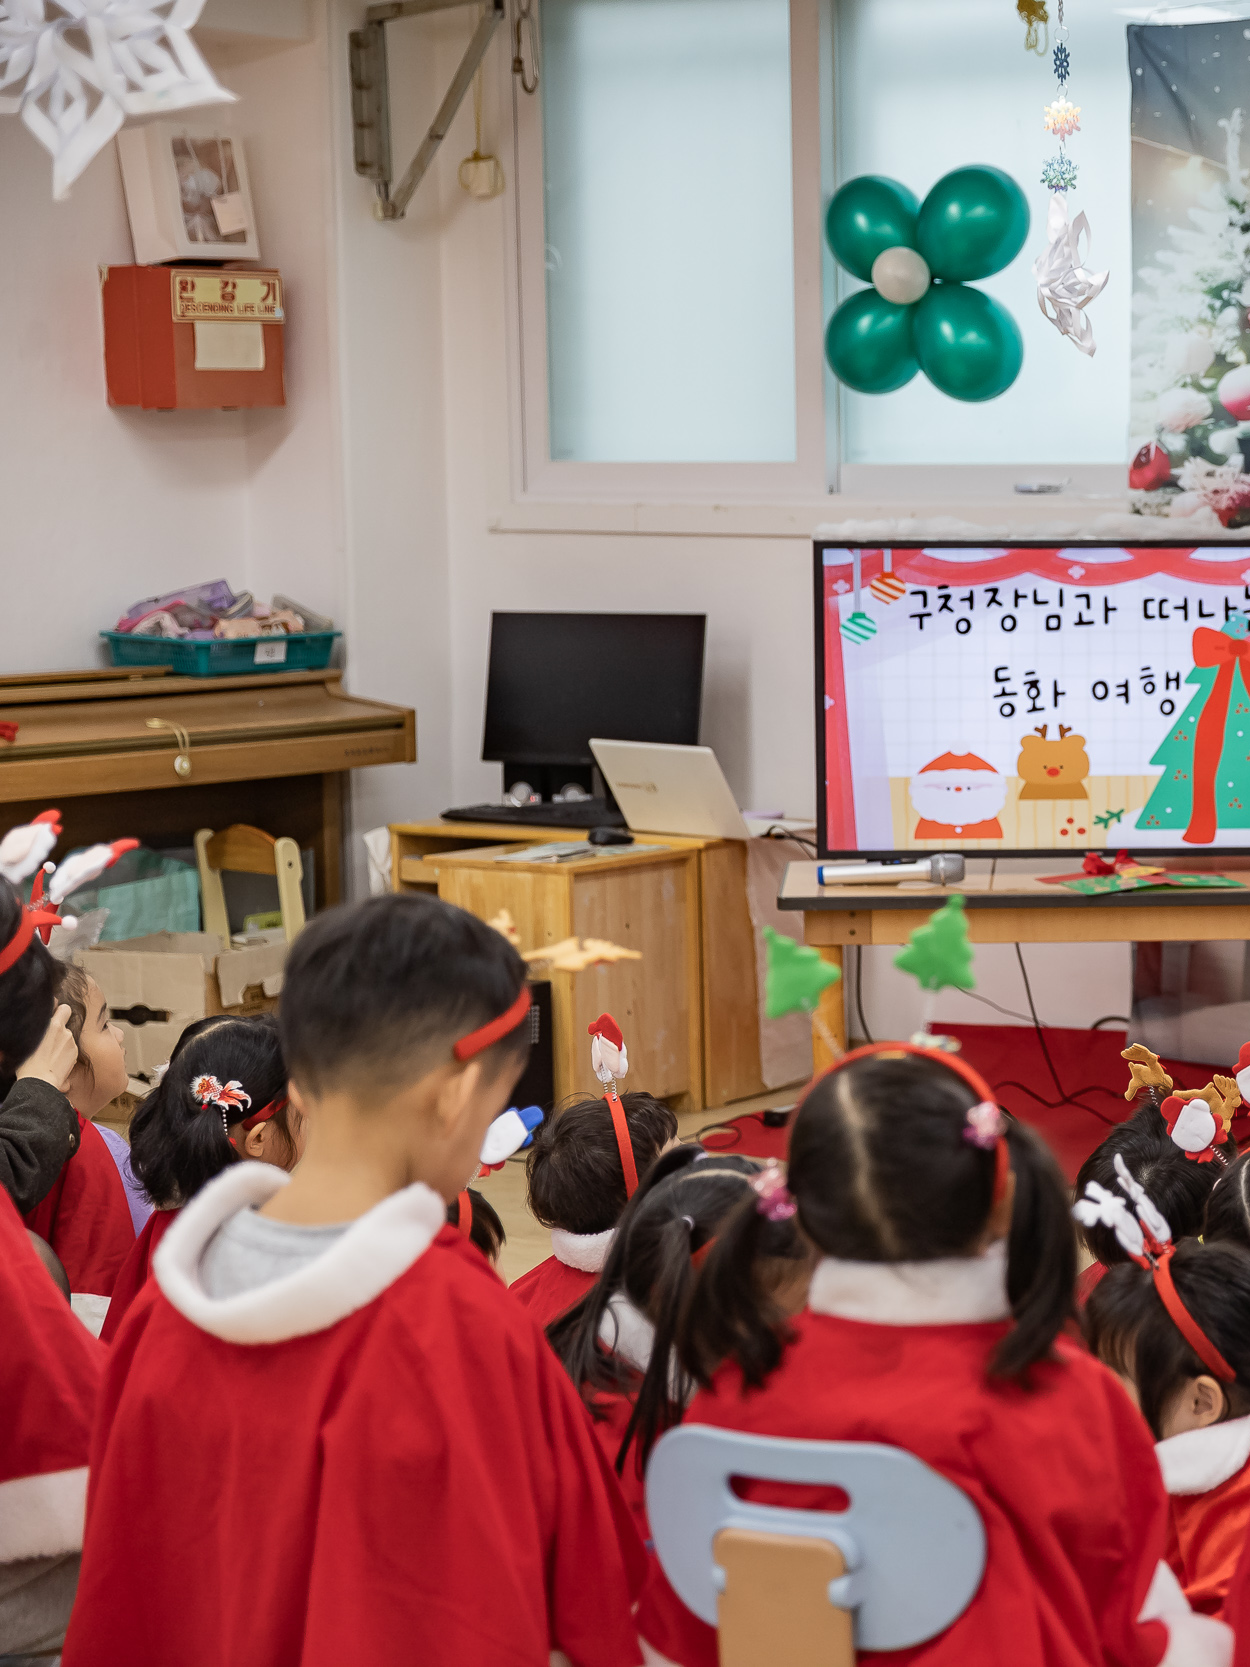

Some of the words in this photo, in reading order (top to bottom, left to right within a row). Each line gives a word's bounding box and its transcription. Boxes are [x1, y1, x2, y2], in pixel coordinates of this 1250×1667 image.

[180, 302, 233, 314] DESCENDING
[237, 303, 255, 314] LIFE
[257, 304, 276, 314] LINE
[908, 585, 1118, 634] 구청장님과
[993, 666, 1067, 718] 동화
[1091, 666, 1182, 716] 여행
